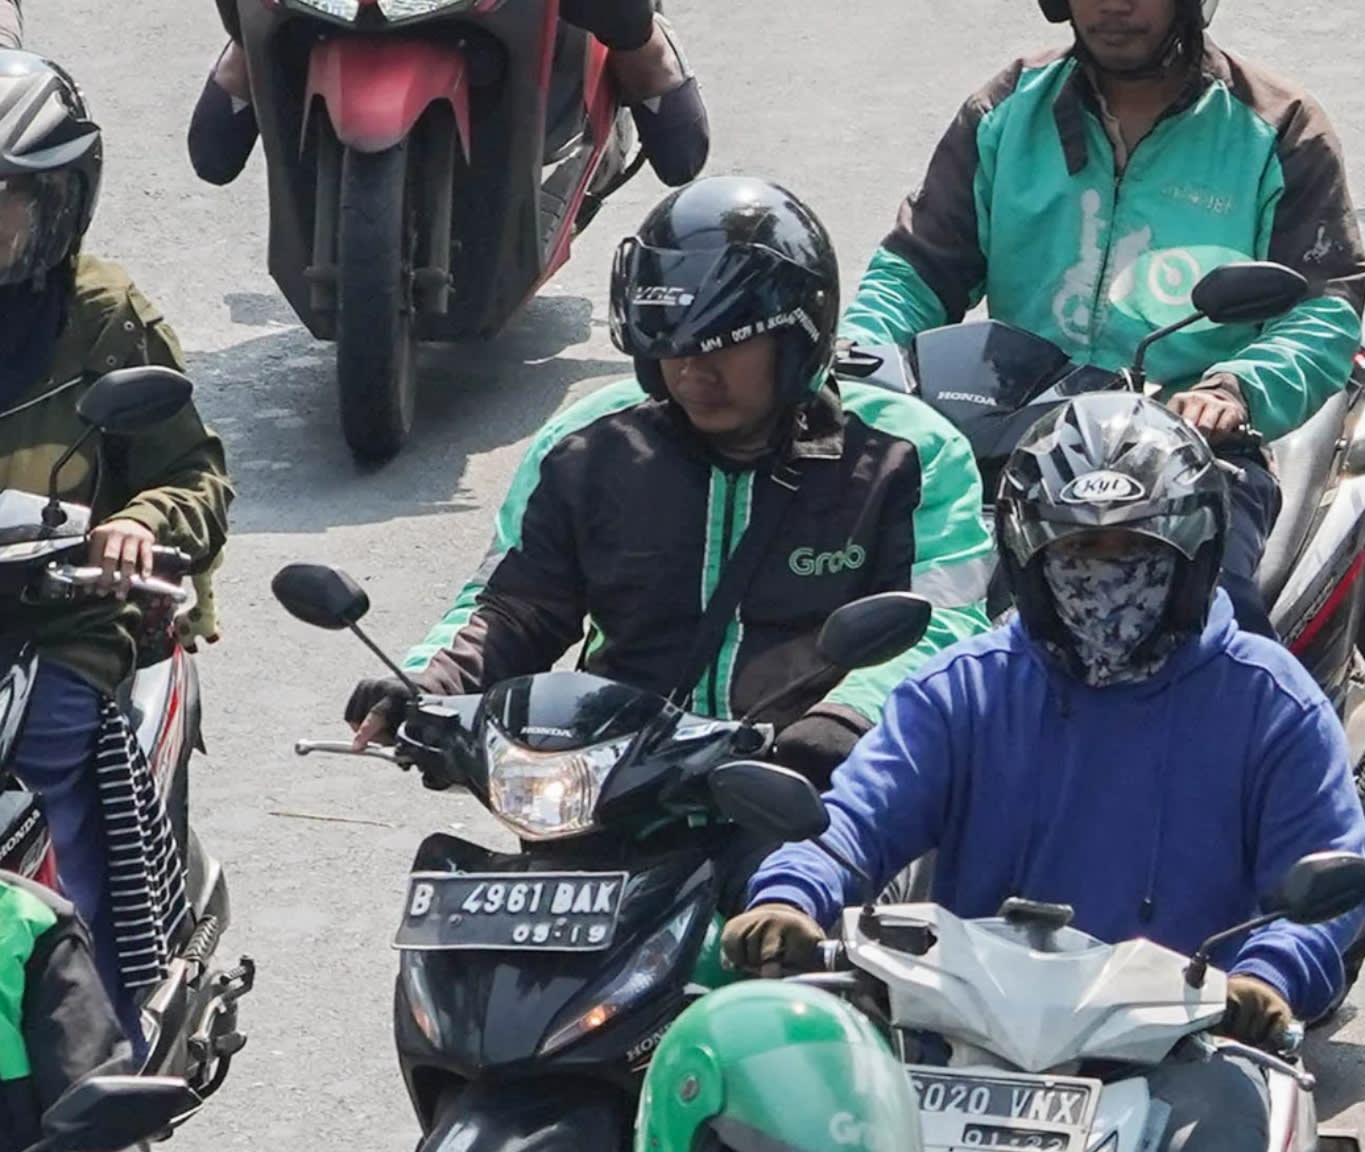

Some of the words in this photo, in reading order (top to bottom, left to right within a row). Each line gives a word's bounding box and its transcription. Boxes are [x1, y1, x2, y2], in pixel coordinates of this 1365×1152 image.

[936, 391, 997, 407] HONDA
[788, 538, 866, 576] Grab
[520, 726, 573, 738] HONDA
[410, 883, 434, 915] B
[462, 882, 543, 914] 4961
[1010, 1089, 1082, 1126] VNX
